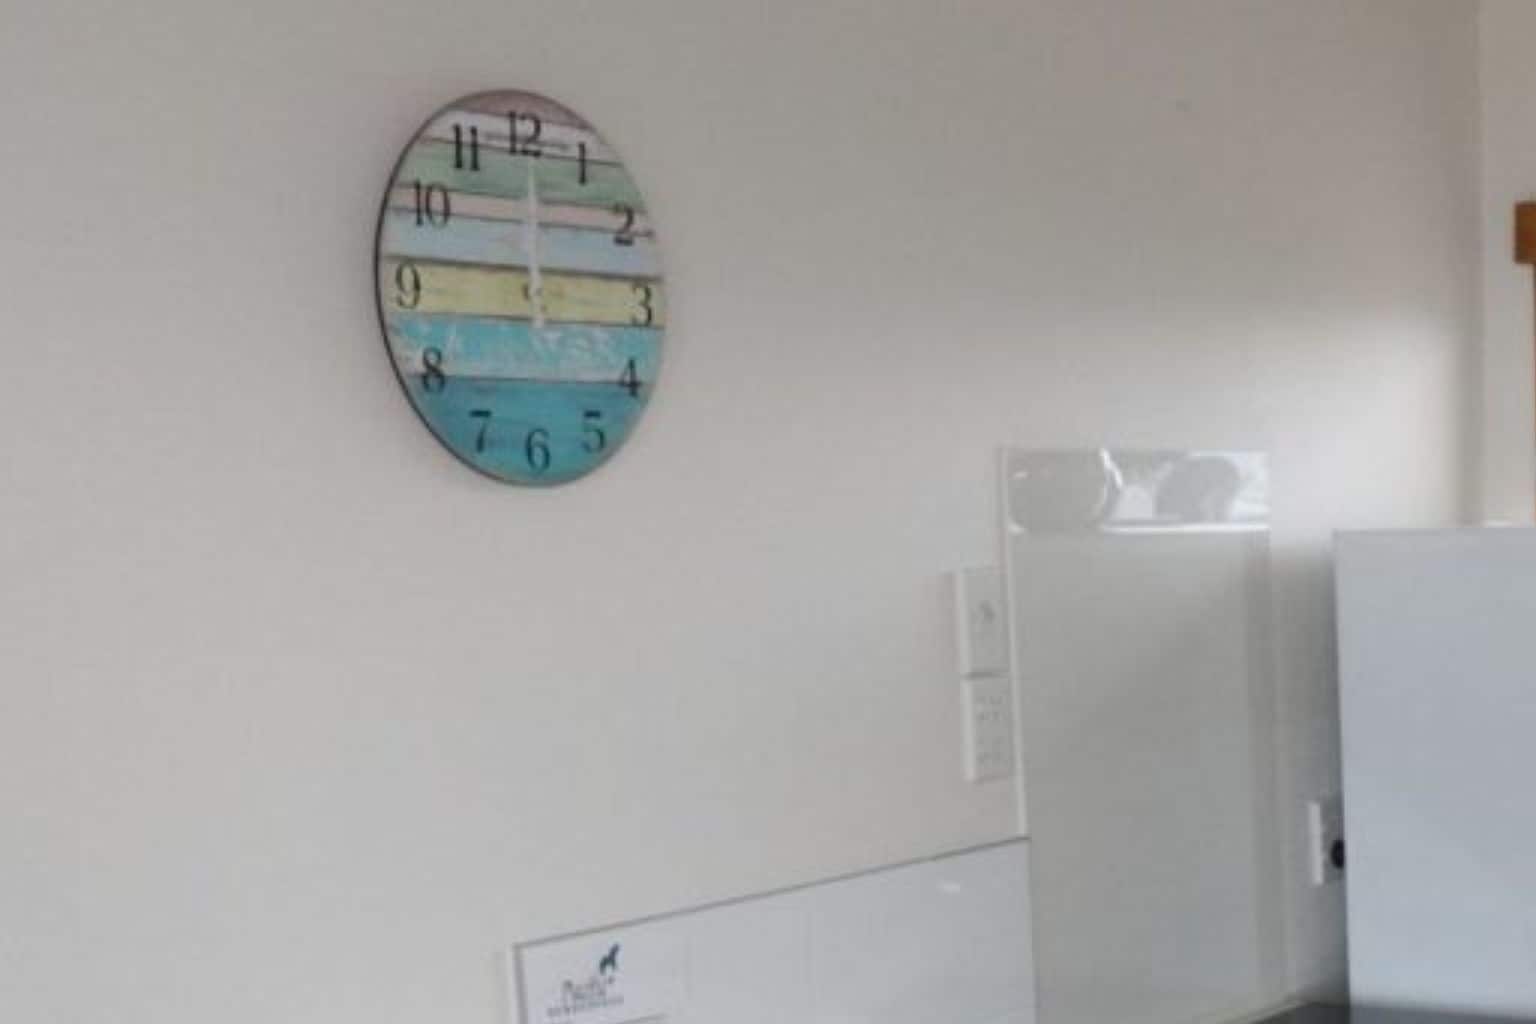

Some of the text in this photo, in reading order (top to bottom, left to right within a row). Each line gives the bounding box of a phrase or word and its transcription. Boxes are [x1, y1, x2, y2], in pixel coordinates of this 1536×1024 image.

[453, 124, 480, 171] 11
[507, 111, 542, 157] 12
[577, 142, 589, 185] 1
[413, 181, 451, 227] 10
[613, 205, 635, 246] 2
[395, 263, 421, 309] 9
[631, 281, 652, 327] 3
[421, 347, 446, 393] 8
[618, 358, 641, 397] 4
[469, 410, 492, 453] 7
[525, 428, 551, 474] 6
[583, 410, 605, 453] 5
